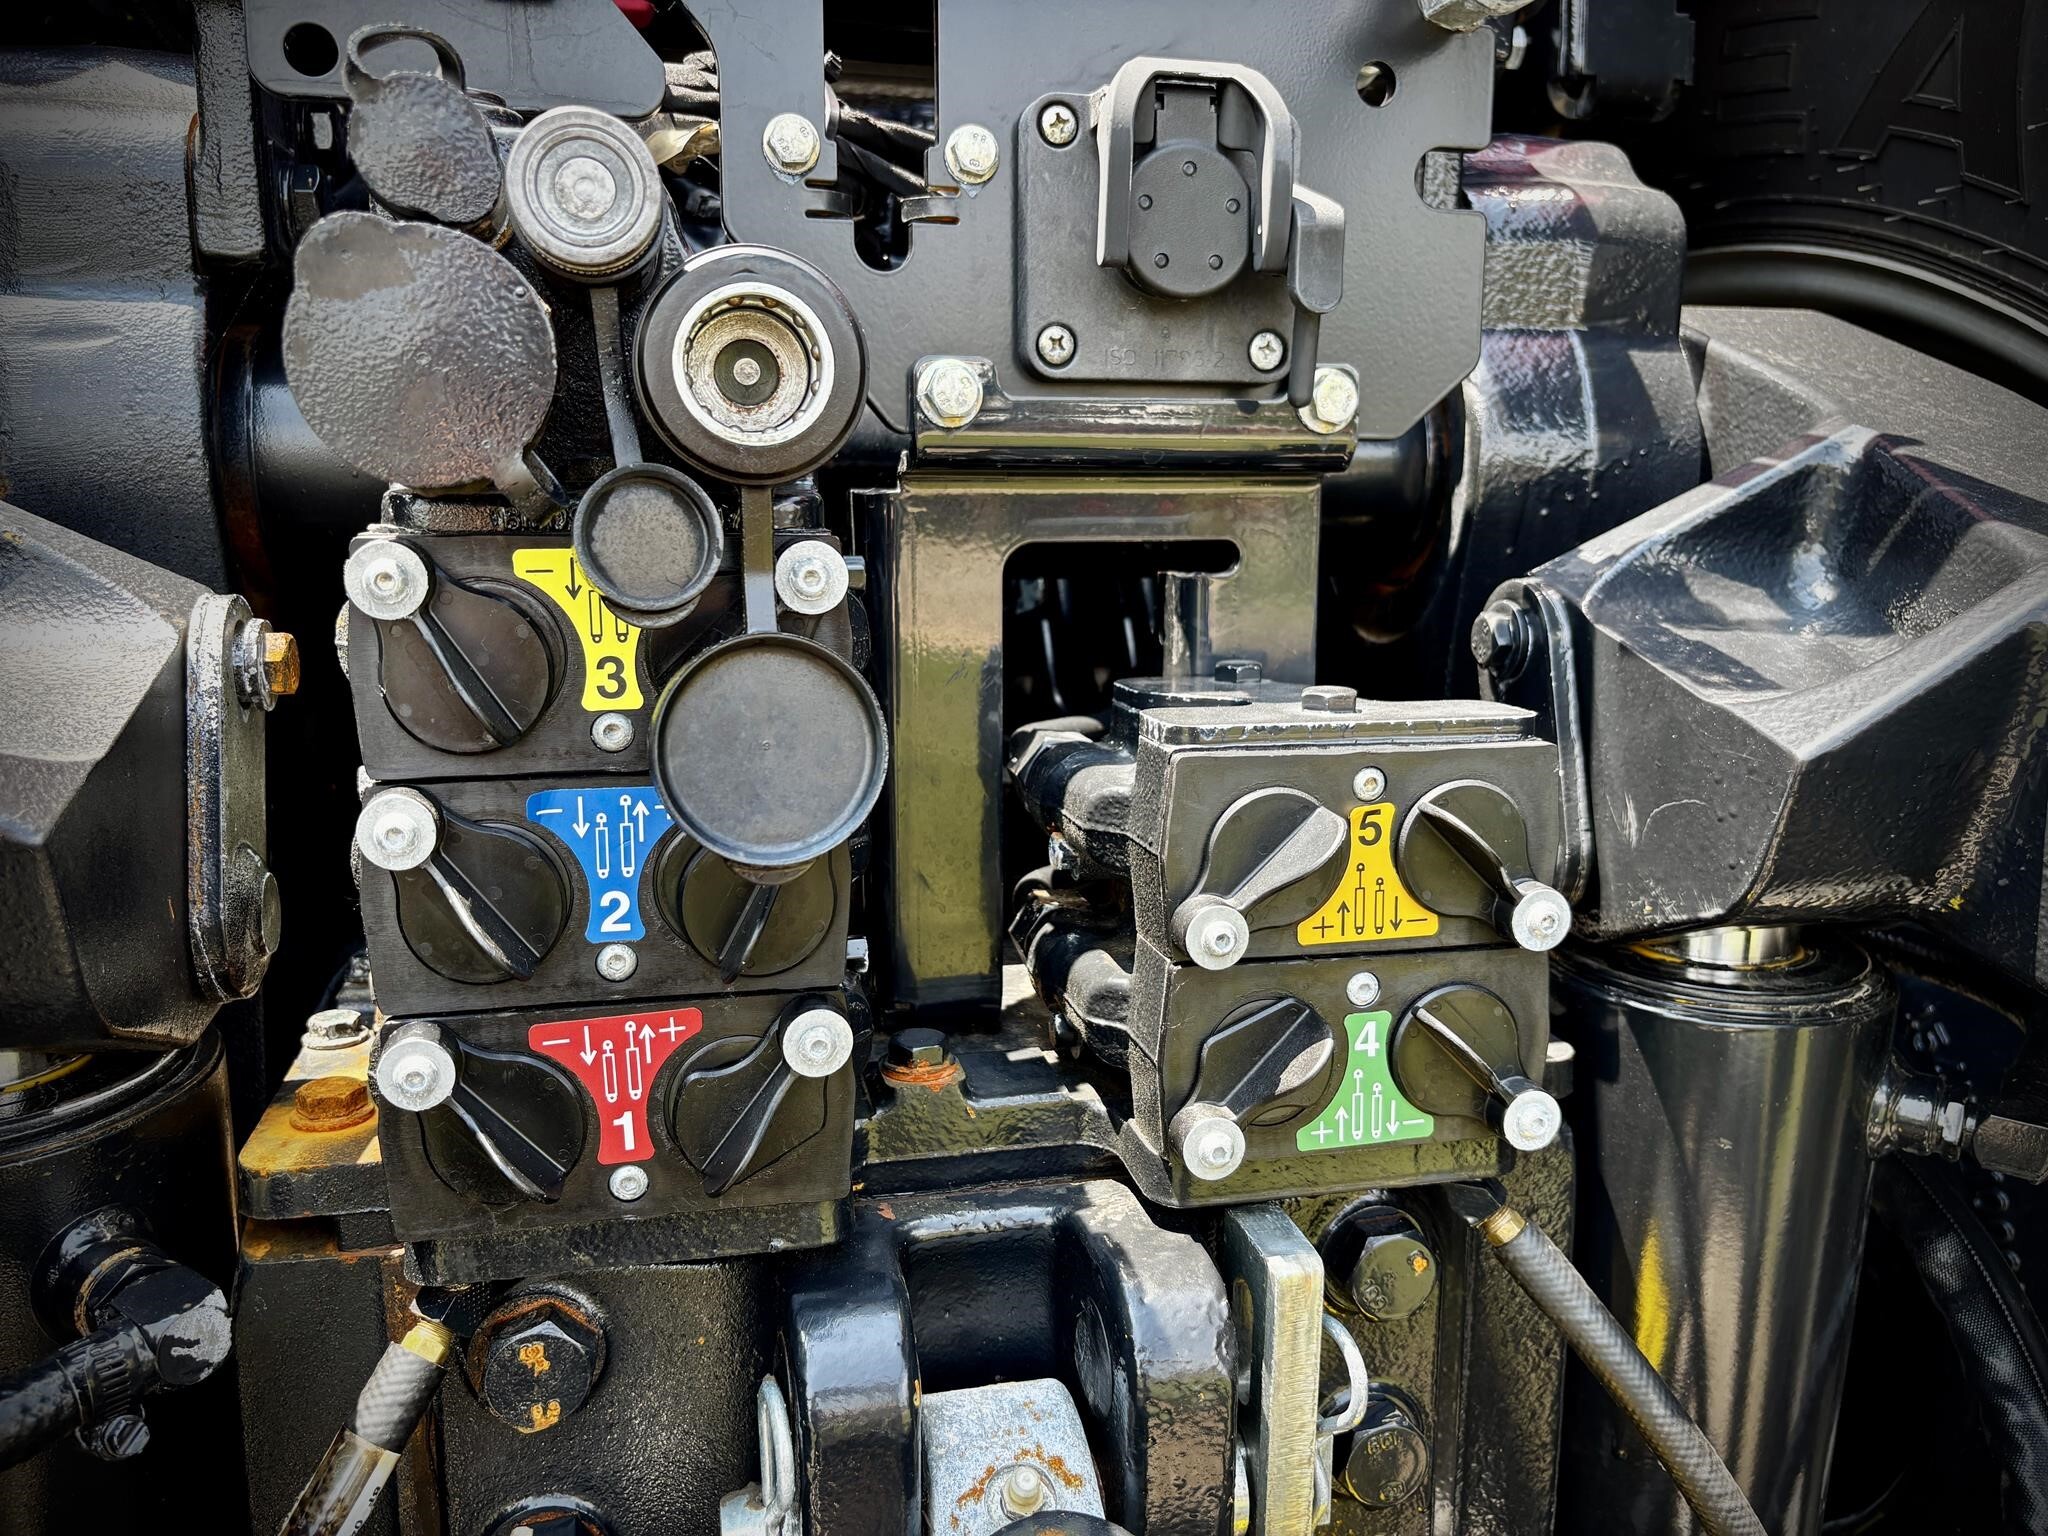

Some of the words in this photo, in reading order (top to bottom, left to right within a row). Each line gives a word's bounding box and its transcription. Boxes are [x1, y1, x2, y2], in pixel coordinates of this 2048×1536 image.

[596, 656, 627, 699] 3
[1358, 809, 1382, 846] 5
[599, 891, 631, 933] 2
[1354, 1021, 1380, 1057] 4
[613, 1111, 635, 1151] 1
